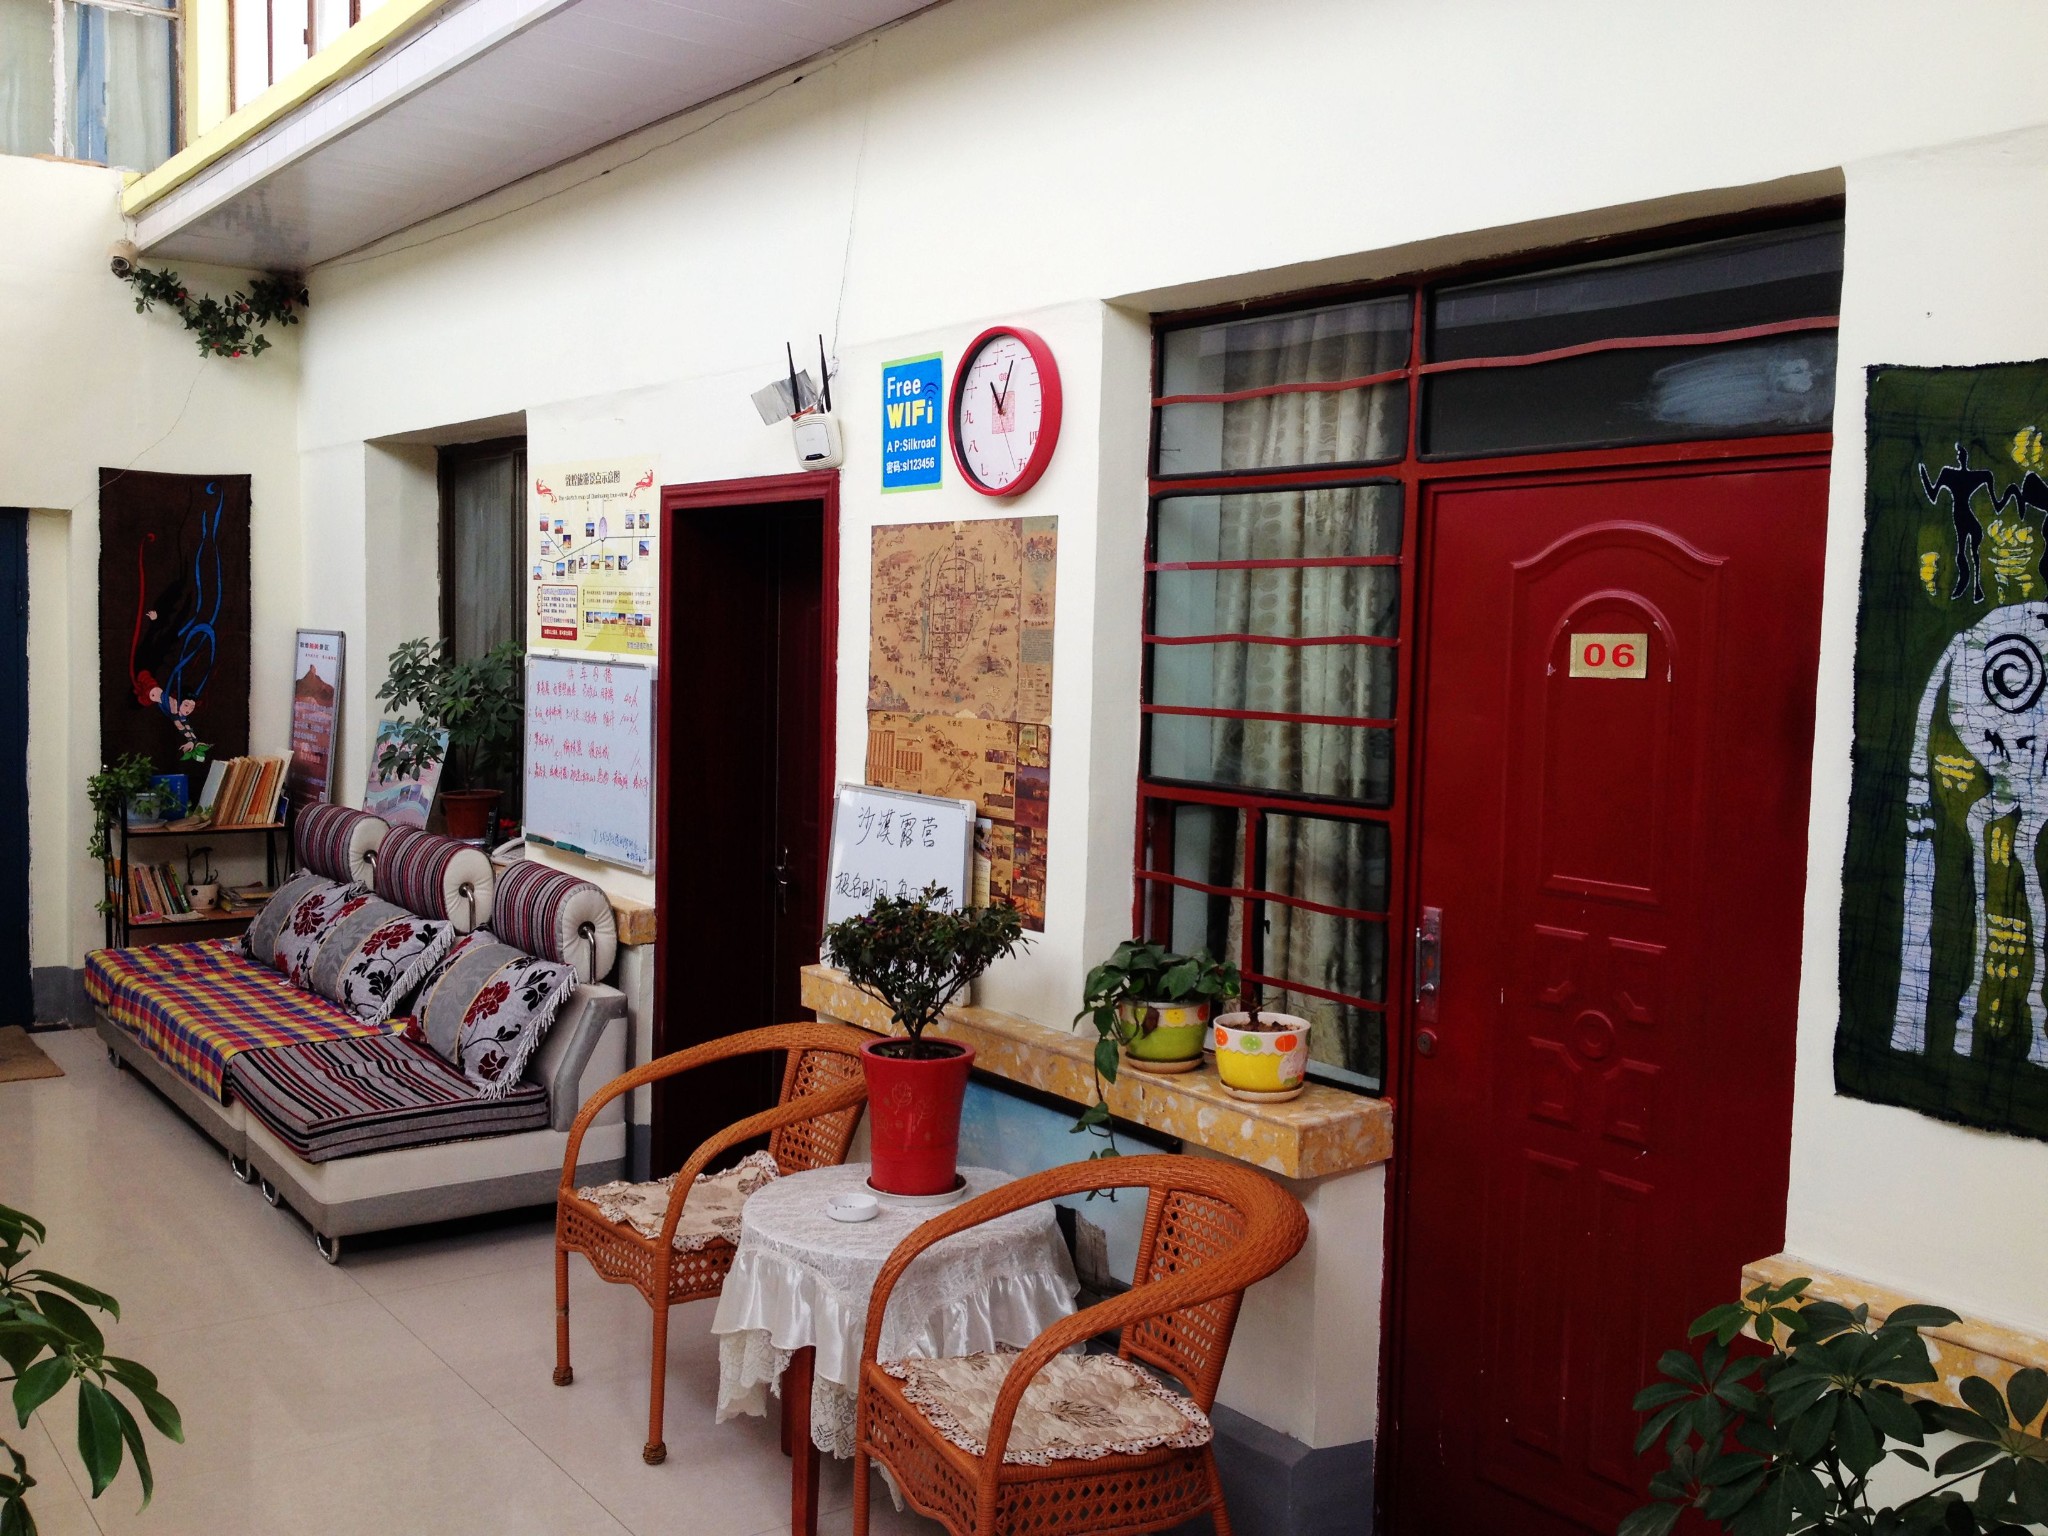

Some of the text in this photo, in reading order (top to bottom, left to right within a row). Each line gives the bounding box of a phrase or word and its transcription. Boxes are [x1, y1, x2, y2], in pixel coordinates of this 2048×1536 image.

[887, 376, 921, 398] Free
[964, 410, 974, 424] 九
[968, 440, 979, 453] 八
[1583, 643, 1635, 668] 06
[856, 806, 938, 848] 沙漠露营
